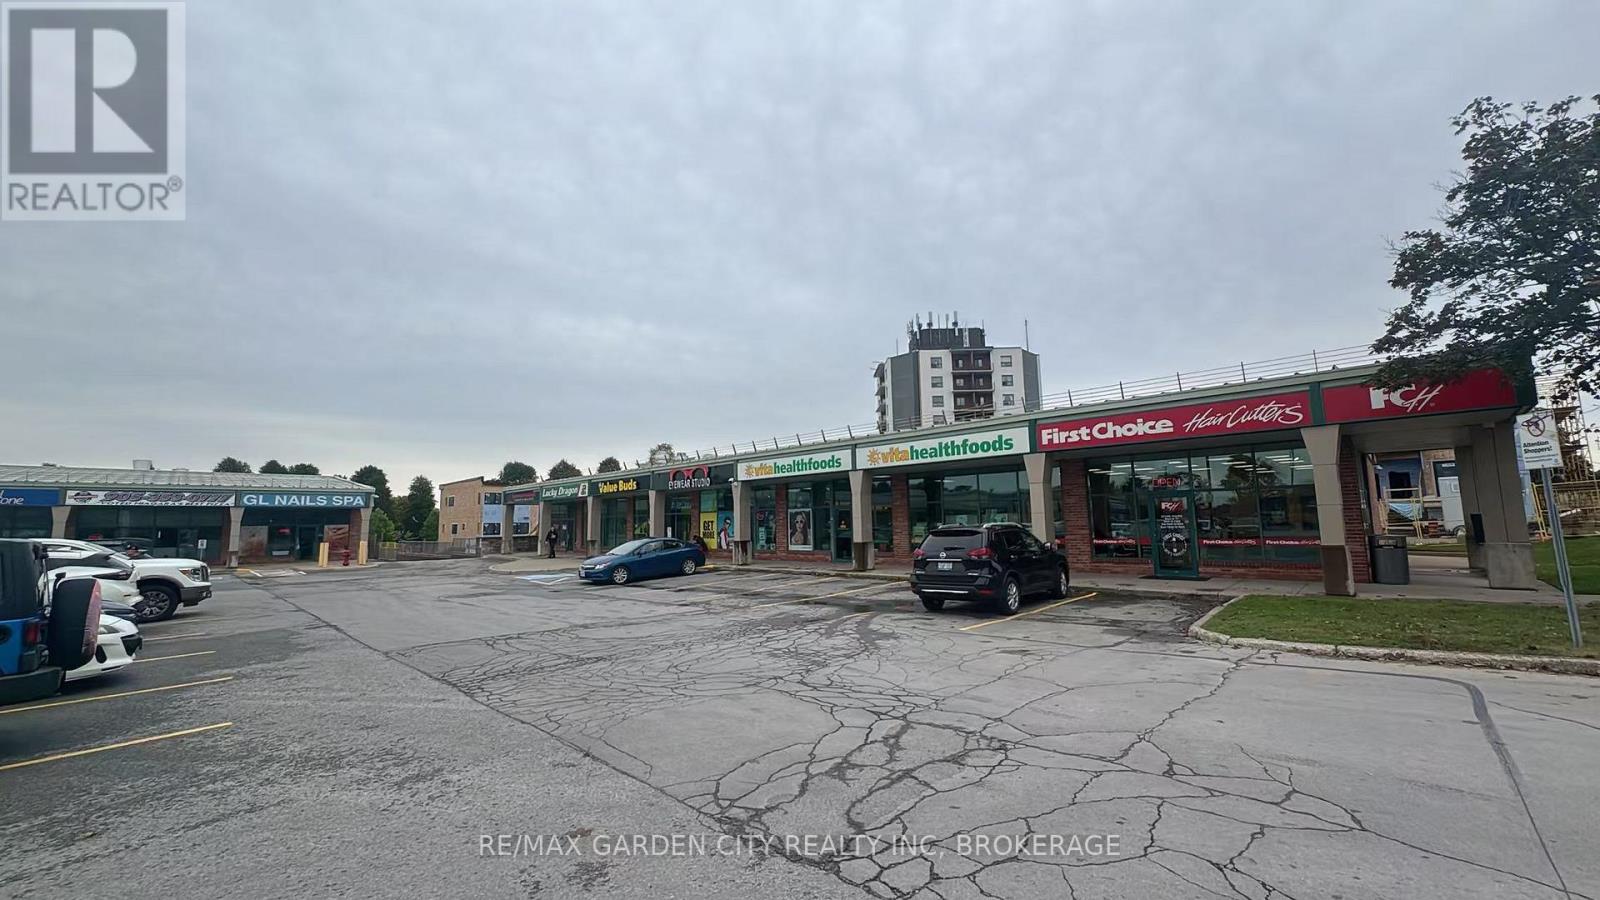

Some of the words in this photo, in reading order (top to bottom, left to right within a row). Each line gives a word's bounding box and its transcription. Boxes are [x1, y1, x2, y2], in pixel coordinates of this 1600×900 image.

[1041, 426, 1091, 446] First
[1091, 418, 1174, 439] Choice
[599, 481, 618, 494] Value
[618, 479, 637, 491] Buds
[668, 478, 691, 490] EYEWEAR
[691, 477, 711, 488] STUDIO
[1152, 478, 1181, 488] OPEN
[542, 487, 557, 498] Lucky
[558, 486, 578, 497] Dragon
[243, 494, 269, 506] GL
[274, 495, 327, 506] NAILS
[332, 495, 365, 506] SPA
[703, 520, 715, 531] GET
